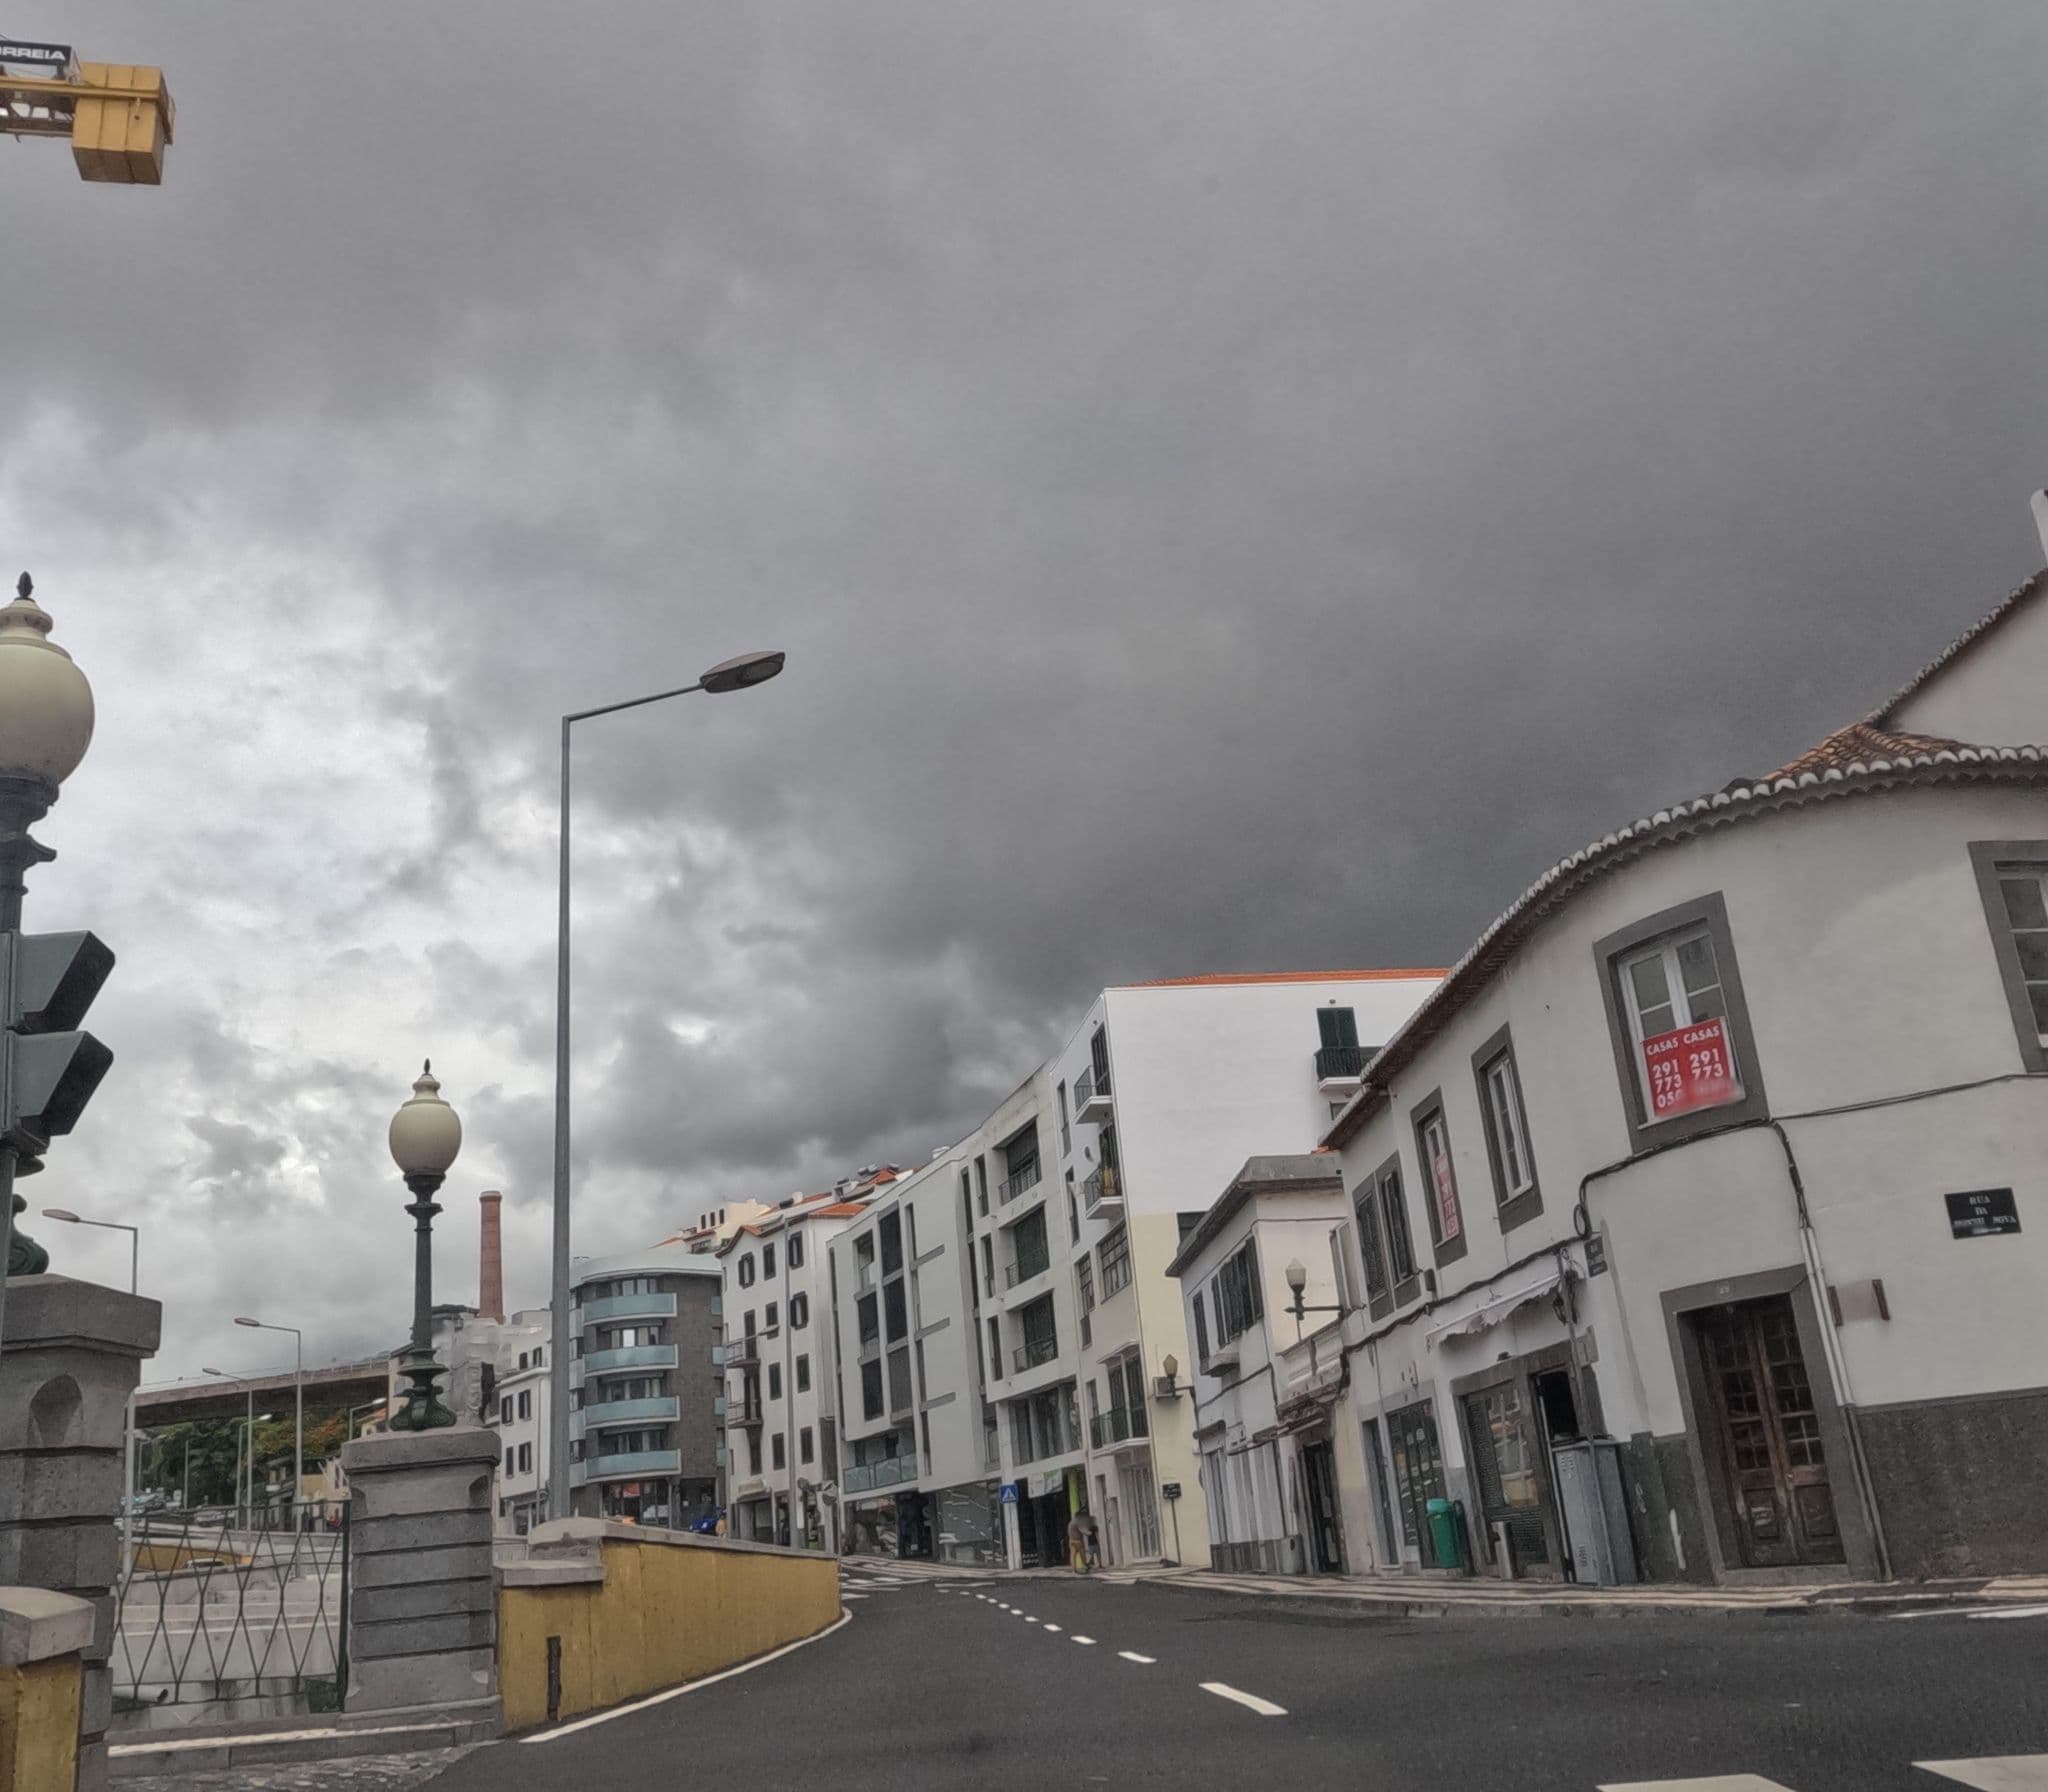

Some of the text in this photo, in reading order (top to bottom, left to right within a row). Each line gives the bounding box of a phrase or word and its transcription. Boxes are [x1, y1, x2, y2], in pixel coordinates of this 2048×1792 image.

[0, 46, 66, 61] RREIA
[1646, 1025, 1720, 1056] CASAS CASAS
[1652, 1048, 1720, 1079] 291 291
[1655, 1074, 1682, 1094] 773
[1692, 1063, 1724, 1081] 773
[1969, 1195, 1991, 1205] RUA
